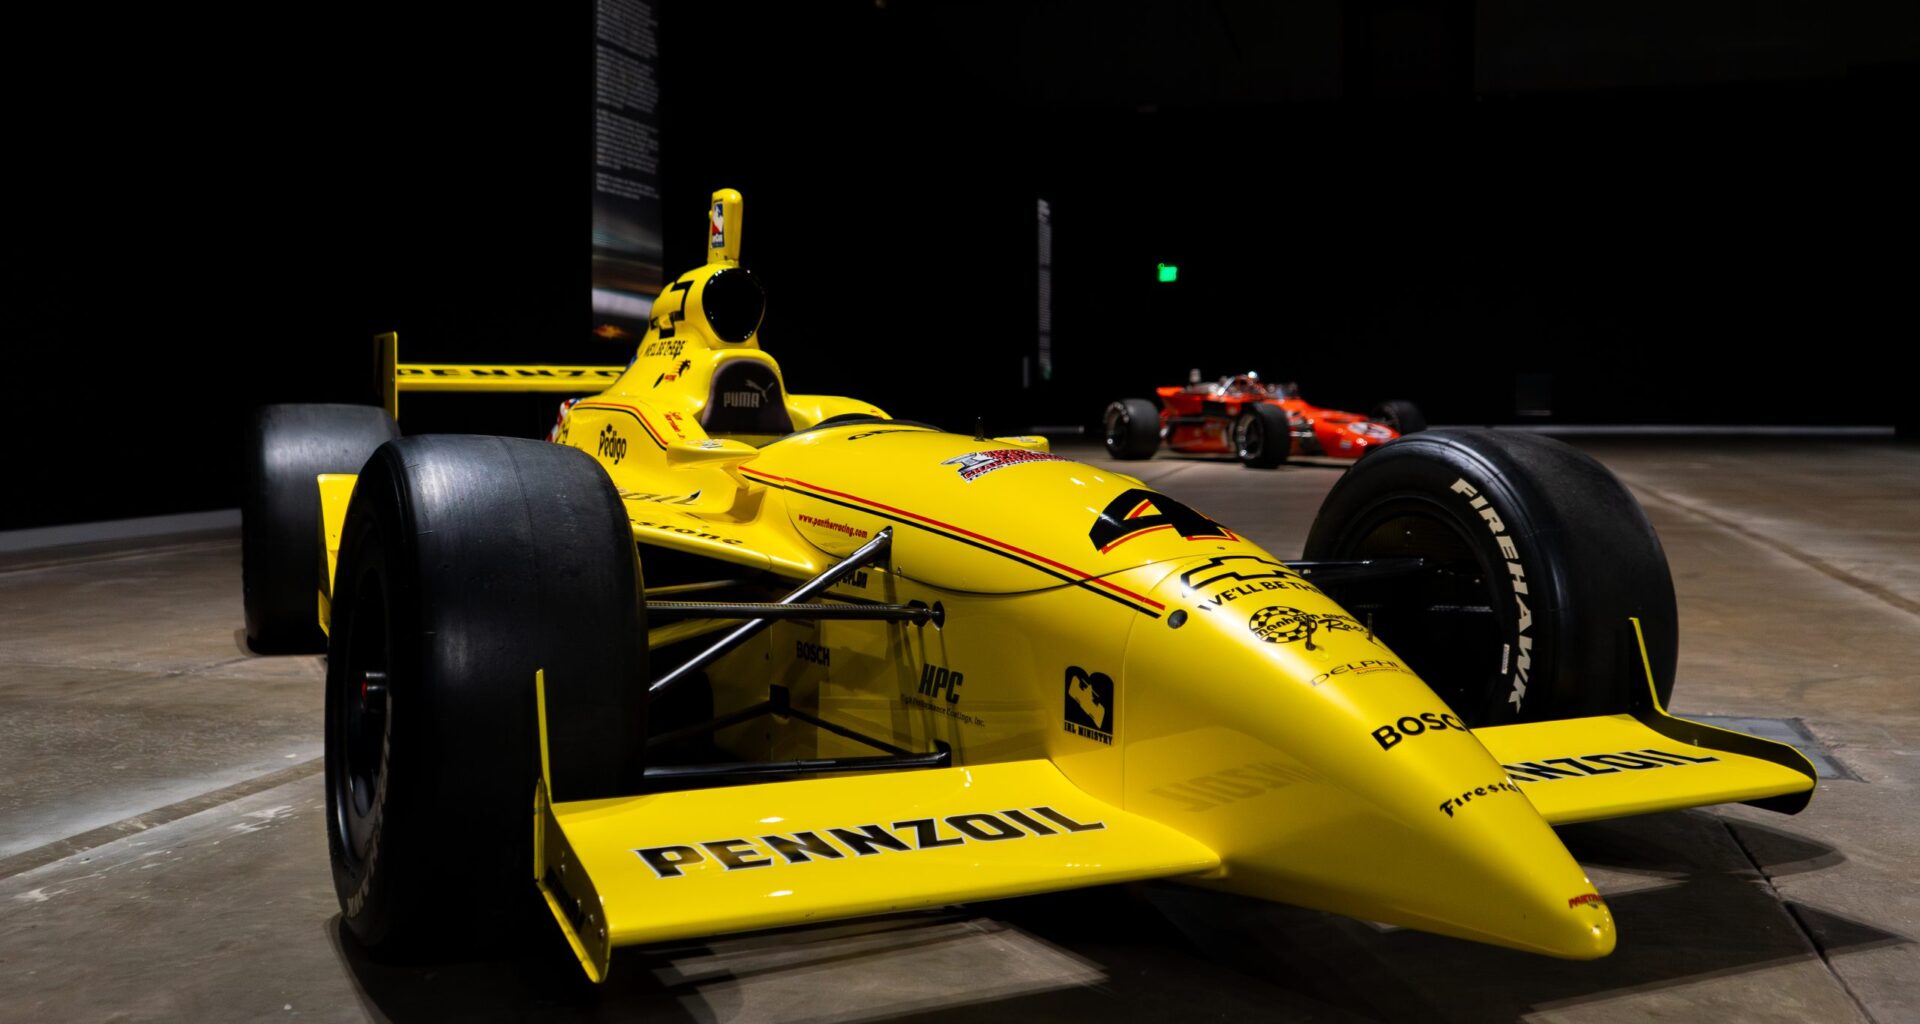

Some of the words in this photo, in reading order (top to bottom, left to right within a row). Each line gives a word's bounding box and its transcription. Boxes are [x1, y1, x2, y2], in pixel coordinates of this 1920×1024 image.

[723, 391, 760, 408] PUMA
[598, 429, 627, 466] Pedigo
[798, 513, 868, 539] www.pantherracing.com
[1089, 488, 1238, 555] 4
[1259, 580, 1288, 591] BE
[1450, 477, 1533, 714] FIREHAWK
[796, 640, 830, 667] BOSCH
[918, 663, 964, 705] HPC
[1311, 660, 1399, 686] DELPHI
[1064, 721, 1077, 735] IRL
[1078, 726, 1113, 746] MINISTRY
[633, 806, 1106, 879] PENNZOIL
